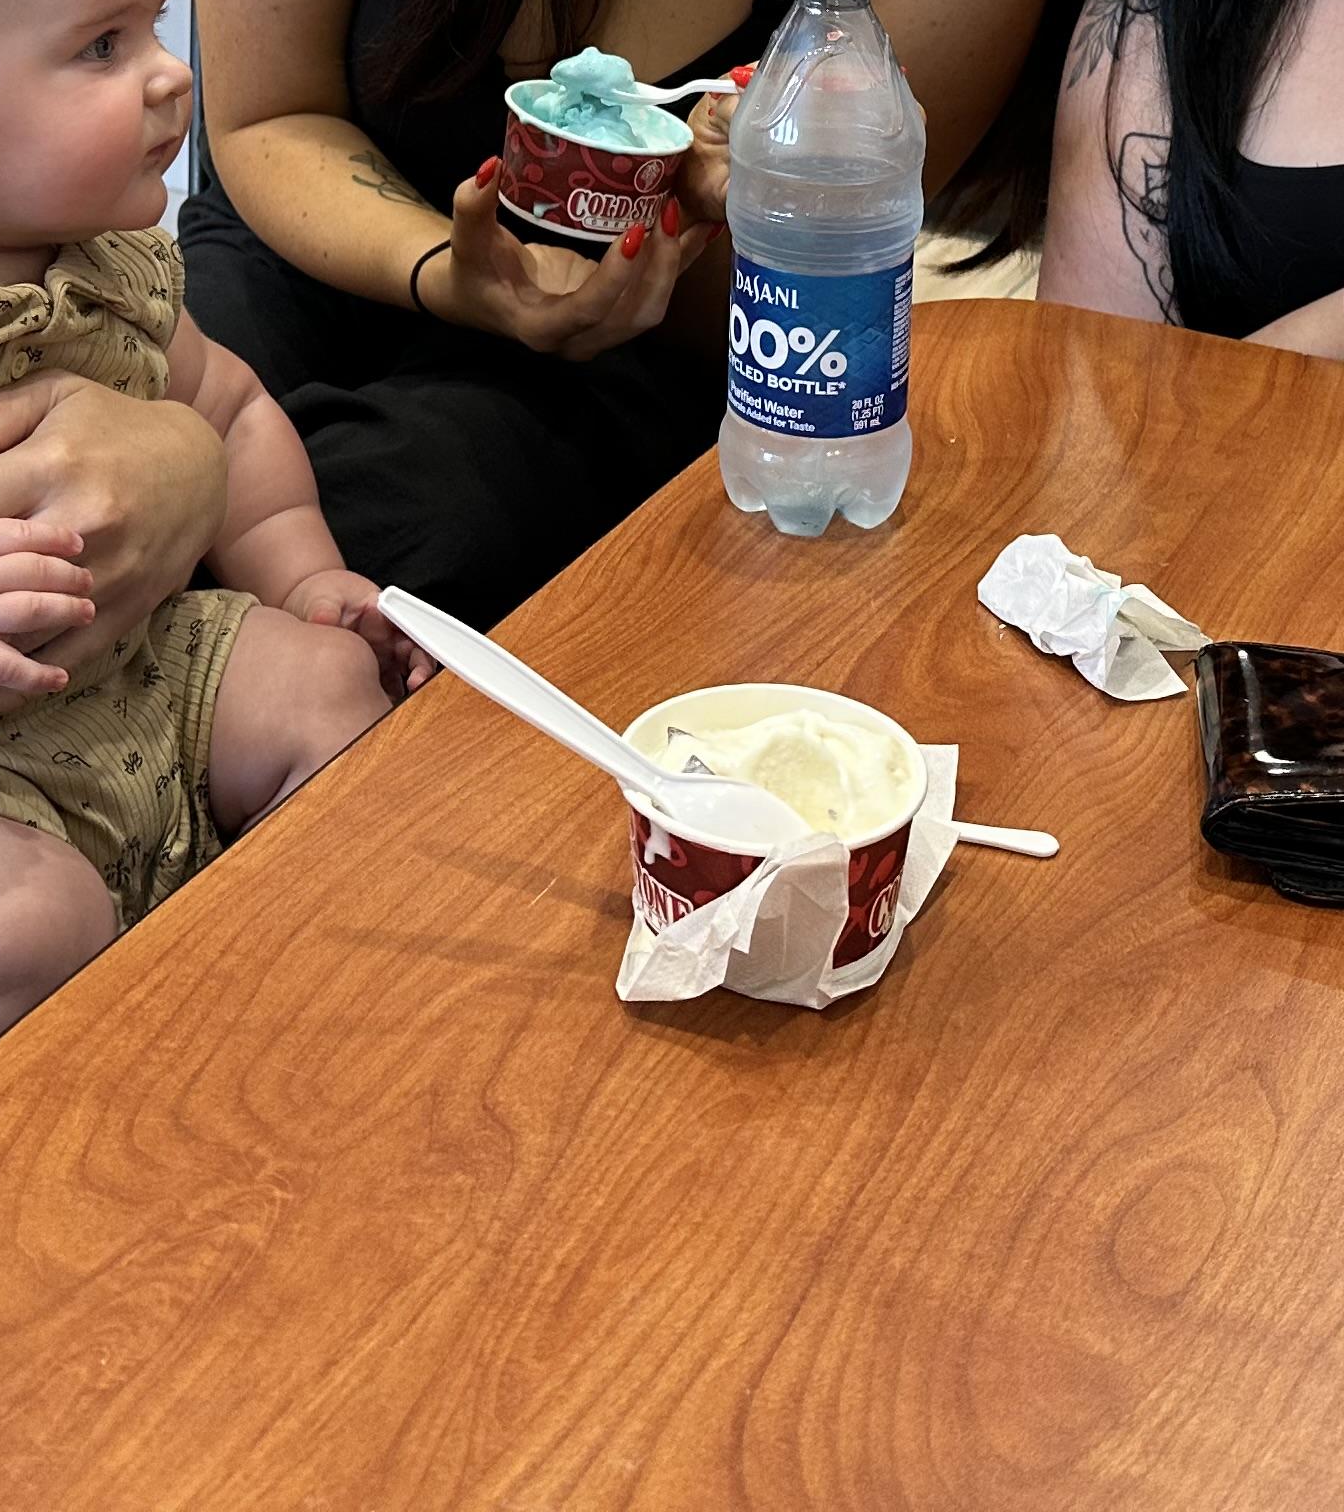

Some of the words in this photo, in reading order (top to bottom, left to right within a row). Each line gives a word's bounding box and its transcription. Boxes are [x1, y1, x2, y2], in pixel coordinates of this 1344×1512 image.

[568, 188, 633, 222] COLD
[735, 269, 800, 310] DASANI
[730, 303, 848, 378] 00%
[730, 380, 762, 410] Purified
[763, 398, 805, 419] Water
[851, 399, 863, 410] 20
[864, 396, 874, 409] FL
[874, 393, 885, 406] OZ
[851, 407, 872, 421] (1.25
[872, 404, 885, 418] PT)
[746, 407, 772, 425] Added
[773, 416, 786, 428] for
[788, 417, 816, 433] Taste
[853, 418, 868, 431] 591
